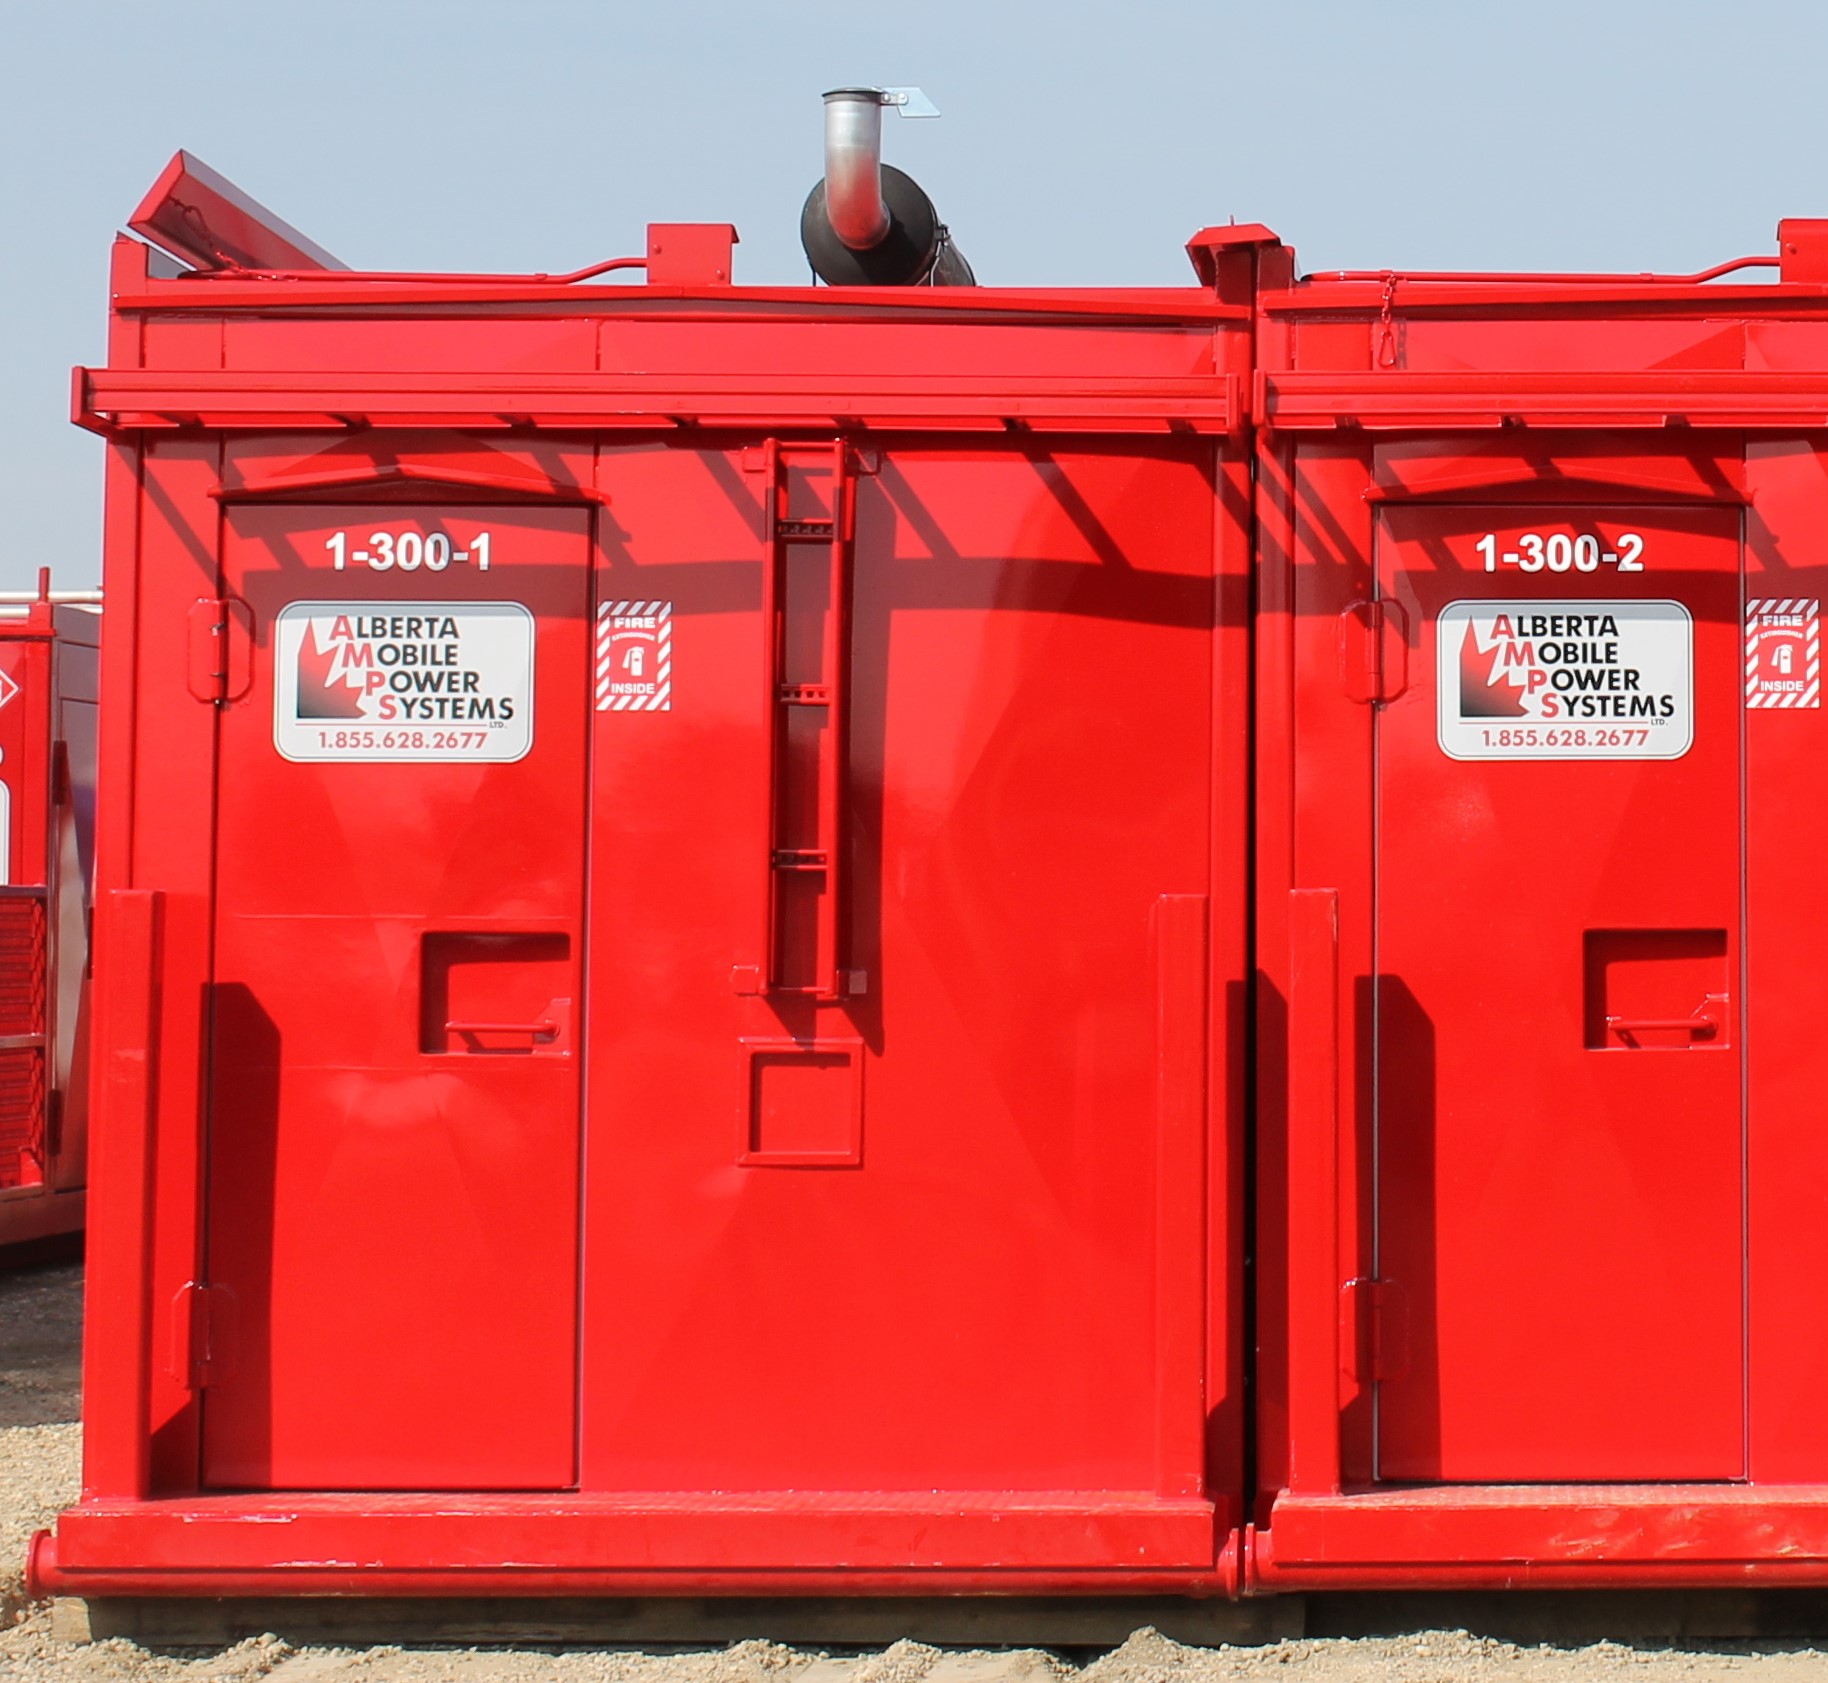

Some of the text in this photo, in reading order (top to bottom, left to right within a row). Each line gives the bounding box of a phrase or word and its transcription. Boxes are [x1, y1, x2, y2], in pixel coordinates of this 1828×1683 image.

[325, 531, 492, 571] 1-300-1
[1475, 533, 1645, 573] 1-300-2
[329, 615, 460, 641] ALBERTA
[614, 617, 656, 629] FIRE
[1490, 614, 1619, 640] ALBERTA
[1762, 615, 1804, 627] FIRE
[341, 643, 458, 668] MOBILE
[1503, 641, 1618, 667] MOBILE
[366, 671, 481, 697] POWER
[611, 683, 656, 695] INSIDE
[1526, 668, 1641, 694] POWER
[1761, 681, 1805, 693] INSIDE
[378, 694, 514, 721] SYSTEMS
[1540, 692, 1675, 719] SYSTEMS
[317, 731, 489, 749] 1.855.628.2677
[1481, 729, 1650, 748] 1.855.628.2677
